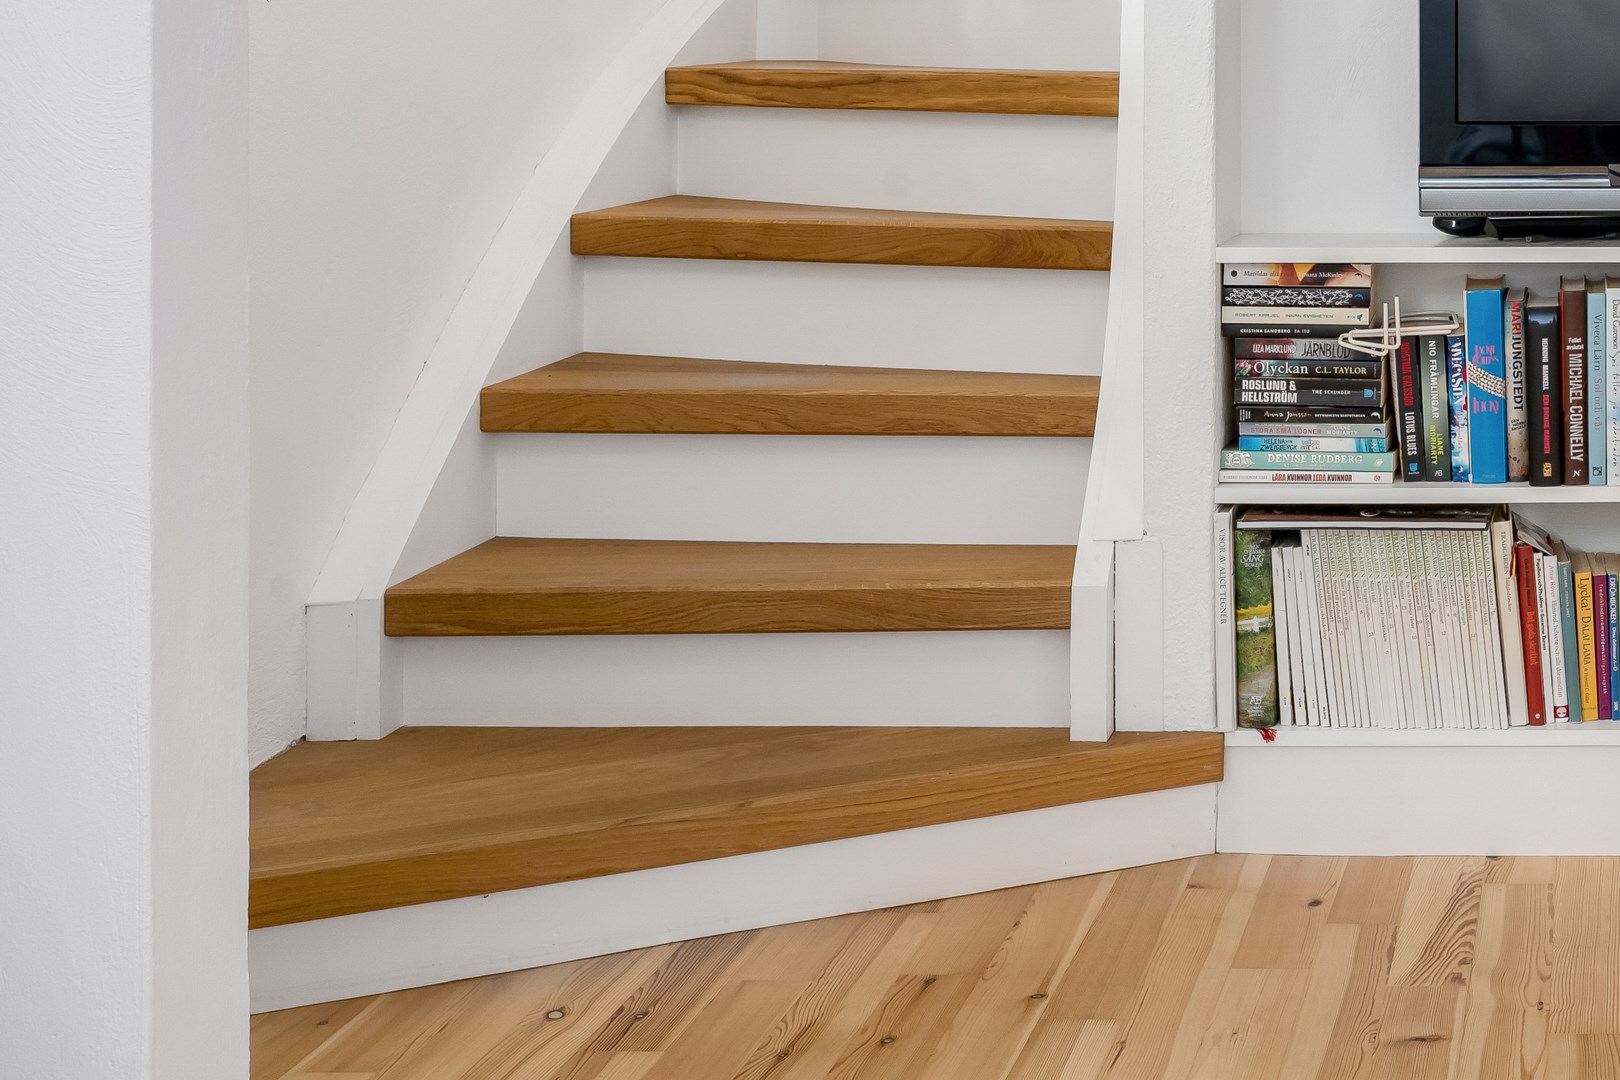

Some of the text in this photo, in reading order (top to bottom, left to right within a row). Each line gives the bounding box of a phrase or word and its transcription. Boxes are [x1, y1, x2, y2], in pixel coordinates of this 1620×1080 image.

[1301, 340, 1350, 359] JÄRNBLOD
[1511, 301, 1524, 412] MARI JUNGSTEDT
[1593, 314, 1603, 371] Viveca Lärn
[1242, 379, 1297, 392] ROSLUND &
[1253, 361, 1309, 378] Olyckan
[1315, 366, 1367, 375] C.L. TAYLOR
[1428, 340, 1440, 419] NIO FRÄMLINGAR
[1241, 390, 1298, 403] HELLSTRÖM
[1568, 353, 1584, 462] MICHAEL CONNELLY
[1404, 411, 1417, 456] LOTUS BLUES
[1267, 453, 1363, 464] DENISE RUDBERG
[1218, 528, 1229, 625] VISOR AV ALICE TEGNÉR
[1577, 577, 1590, 612] Lycka!
[1581, 615, 1592, 666] DALAI LAMA
